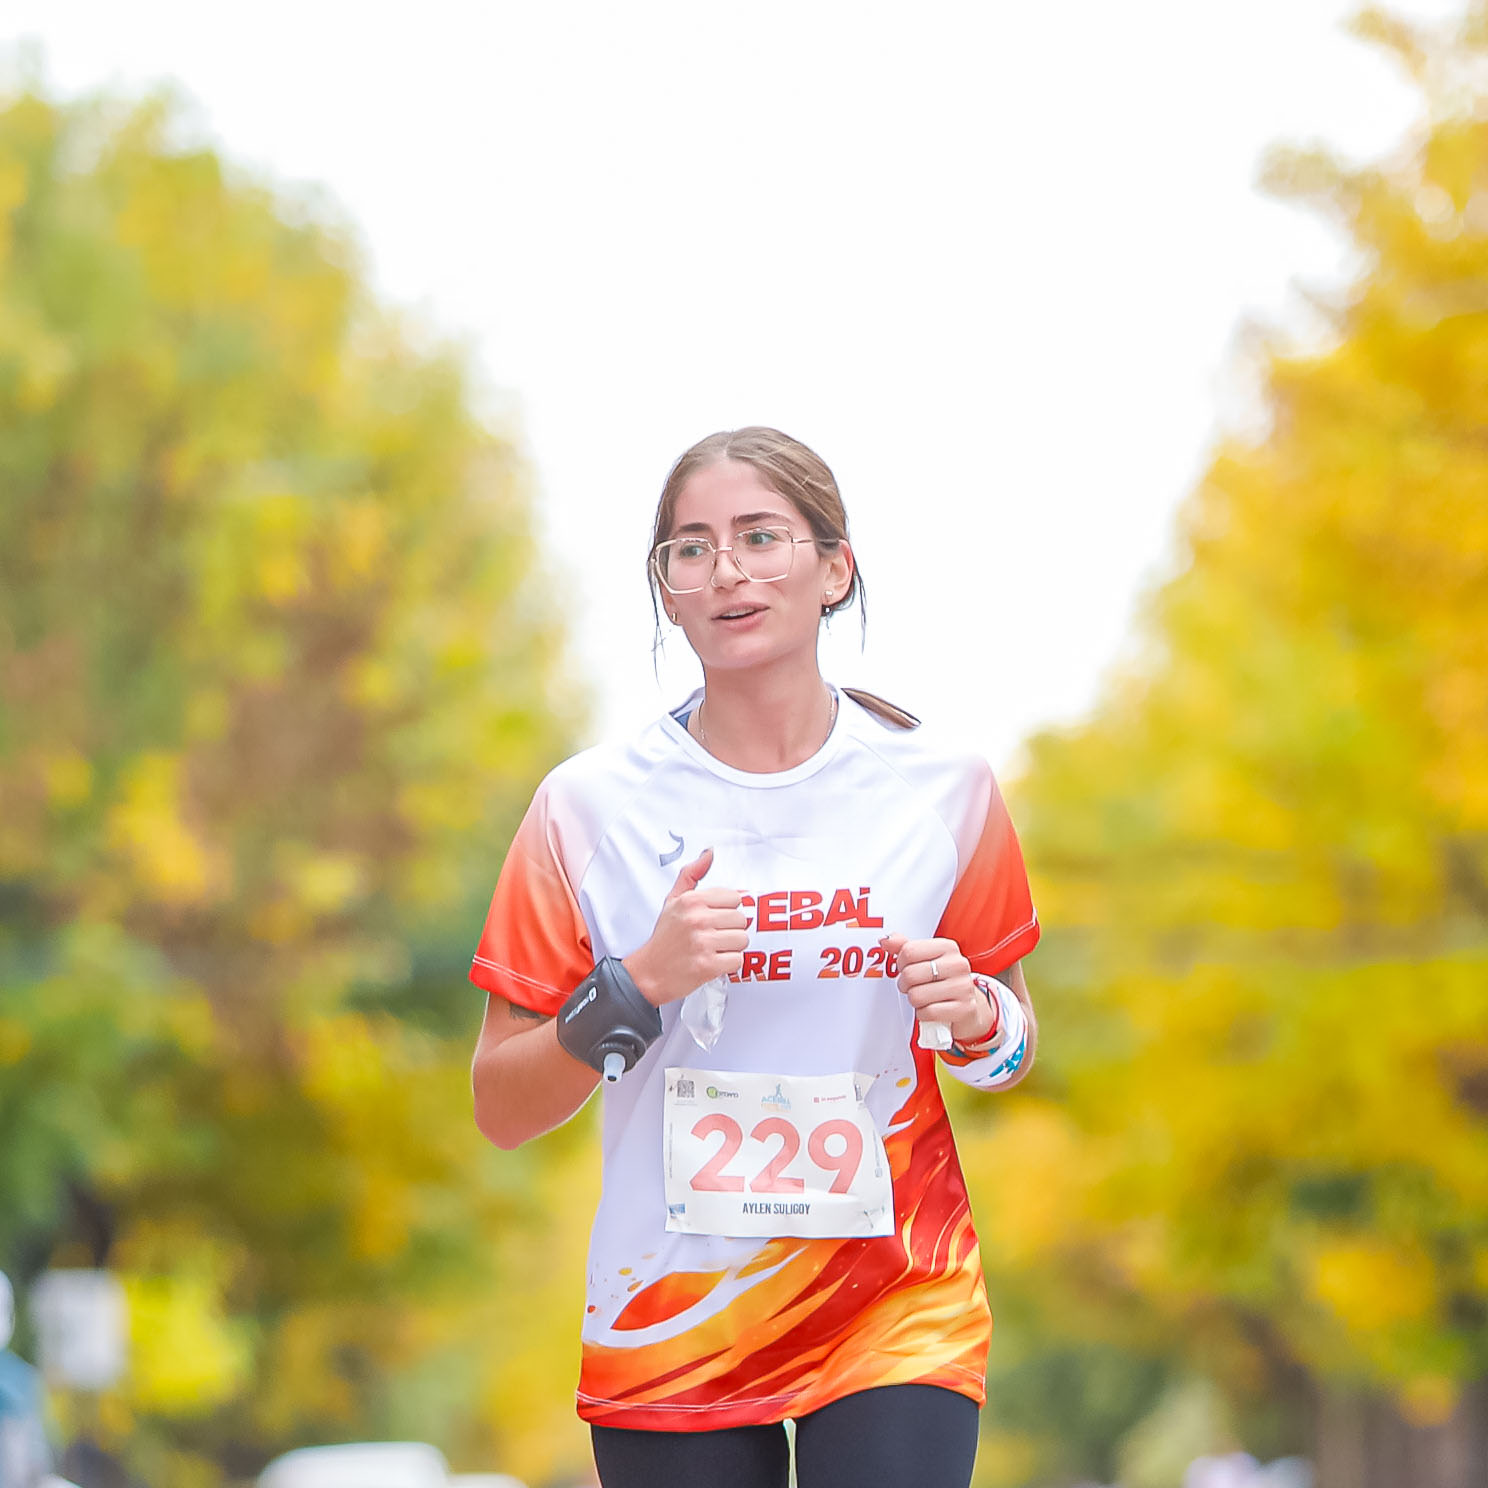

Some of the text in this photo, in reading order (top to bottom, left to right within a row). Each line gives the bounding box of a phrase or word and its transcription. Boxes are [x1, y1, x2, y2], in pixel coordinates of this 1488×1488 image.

[736, 887, 884, 933] CEBAL
[817, 945, 900, 979] 2026
[689, 1113, 864, 1195] 229
[742, 1202, 772, 1215] AYLEN
